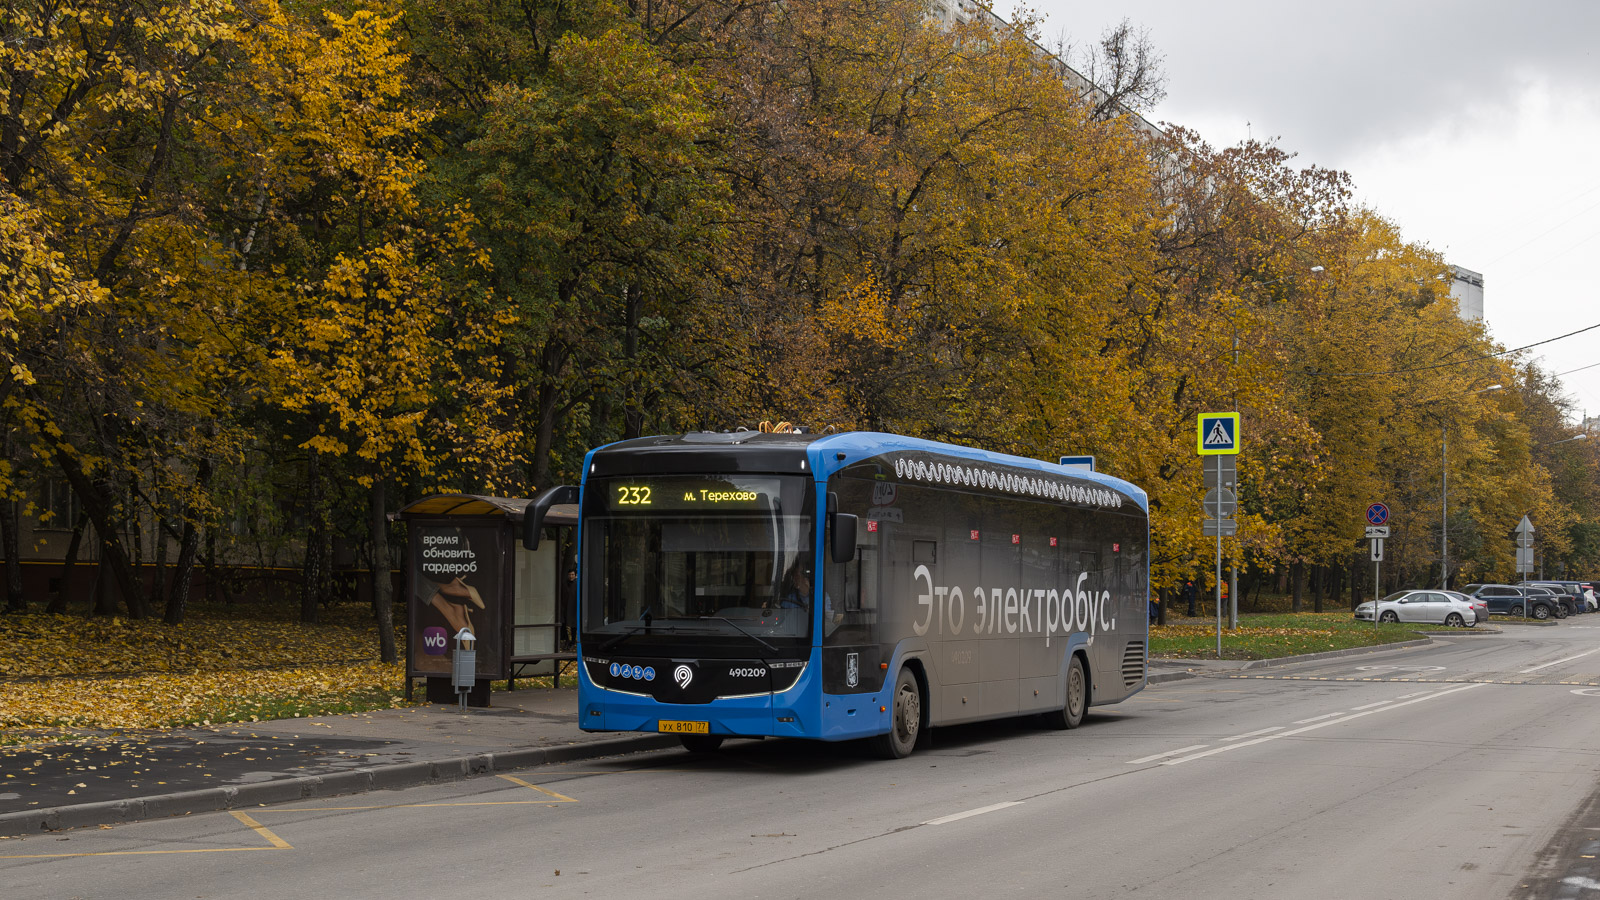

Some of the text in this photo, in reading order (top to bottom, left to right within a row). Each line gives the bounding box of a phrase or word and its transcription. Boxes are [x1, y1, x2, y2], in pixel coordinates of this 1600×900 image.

[618, 486, 757, 505] 232 м. Терехово
[423, 535, 459, 546] время
[423, 547, 476, 559] обновить
[423, 561, 478, 574] гардероб
[912, 564, 1116, 648] Это электробус.
[424, 632, 447, 648] wb
[729, 668, 766, 677] 490209
[676, 722, 693, 732] 810
[697, 722, 706, 730] 77
